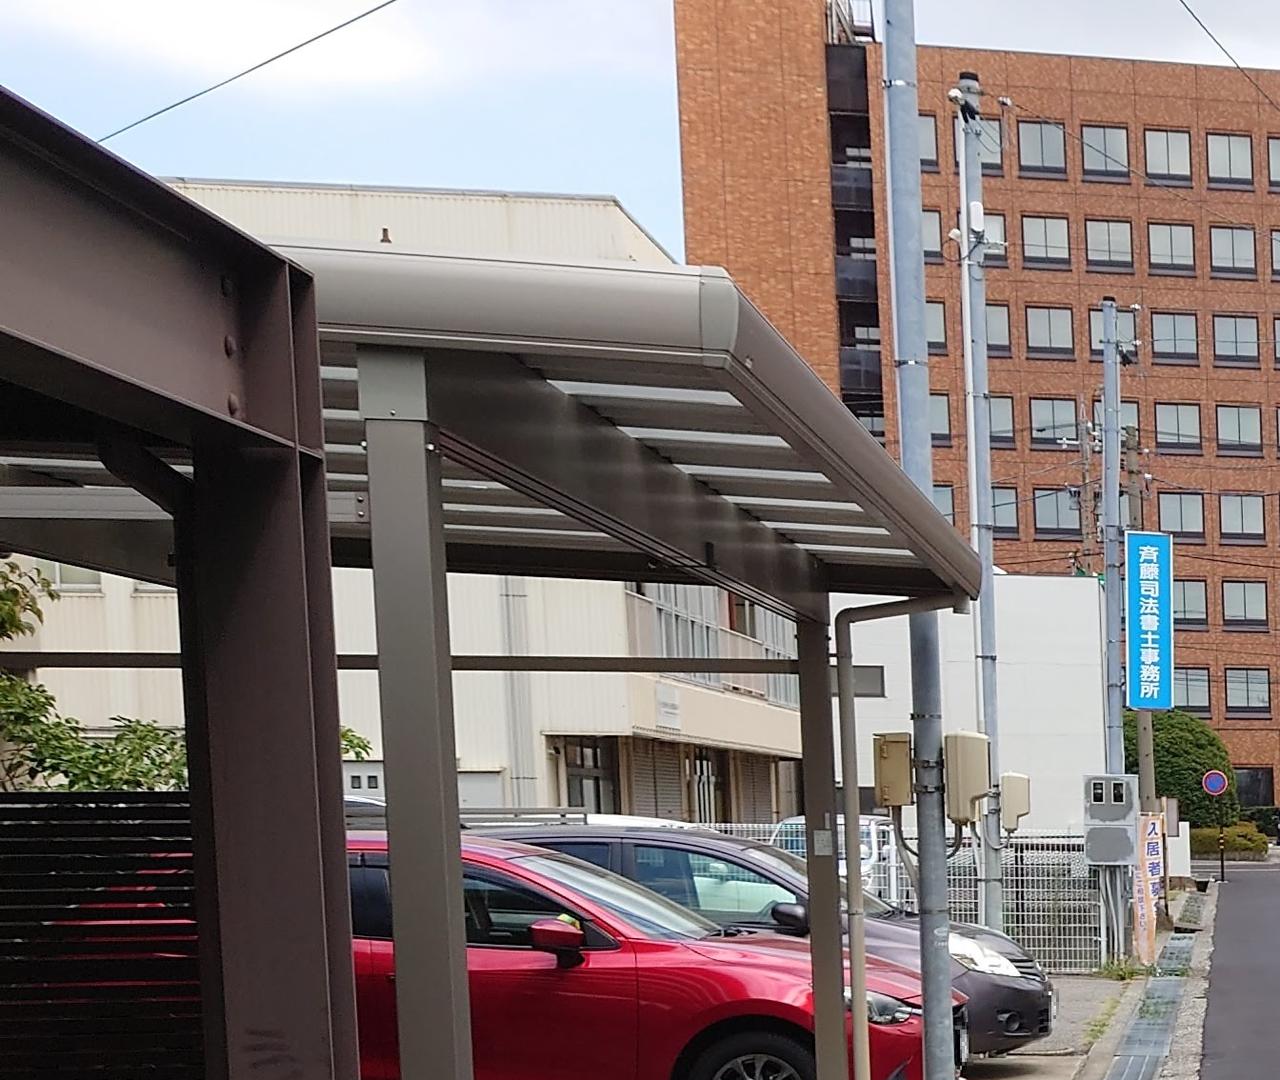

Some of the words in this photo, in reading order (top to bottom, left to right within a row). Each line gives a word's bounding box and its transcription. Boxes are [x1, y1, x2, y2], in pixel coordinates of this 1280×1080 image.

[1139, 546, 1160, 699] 斉藤司法書士事務所
